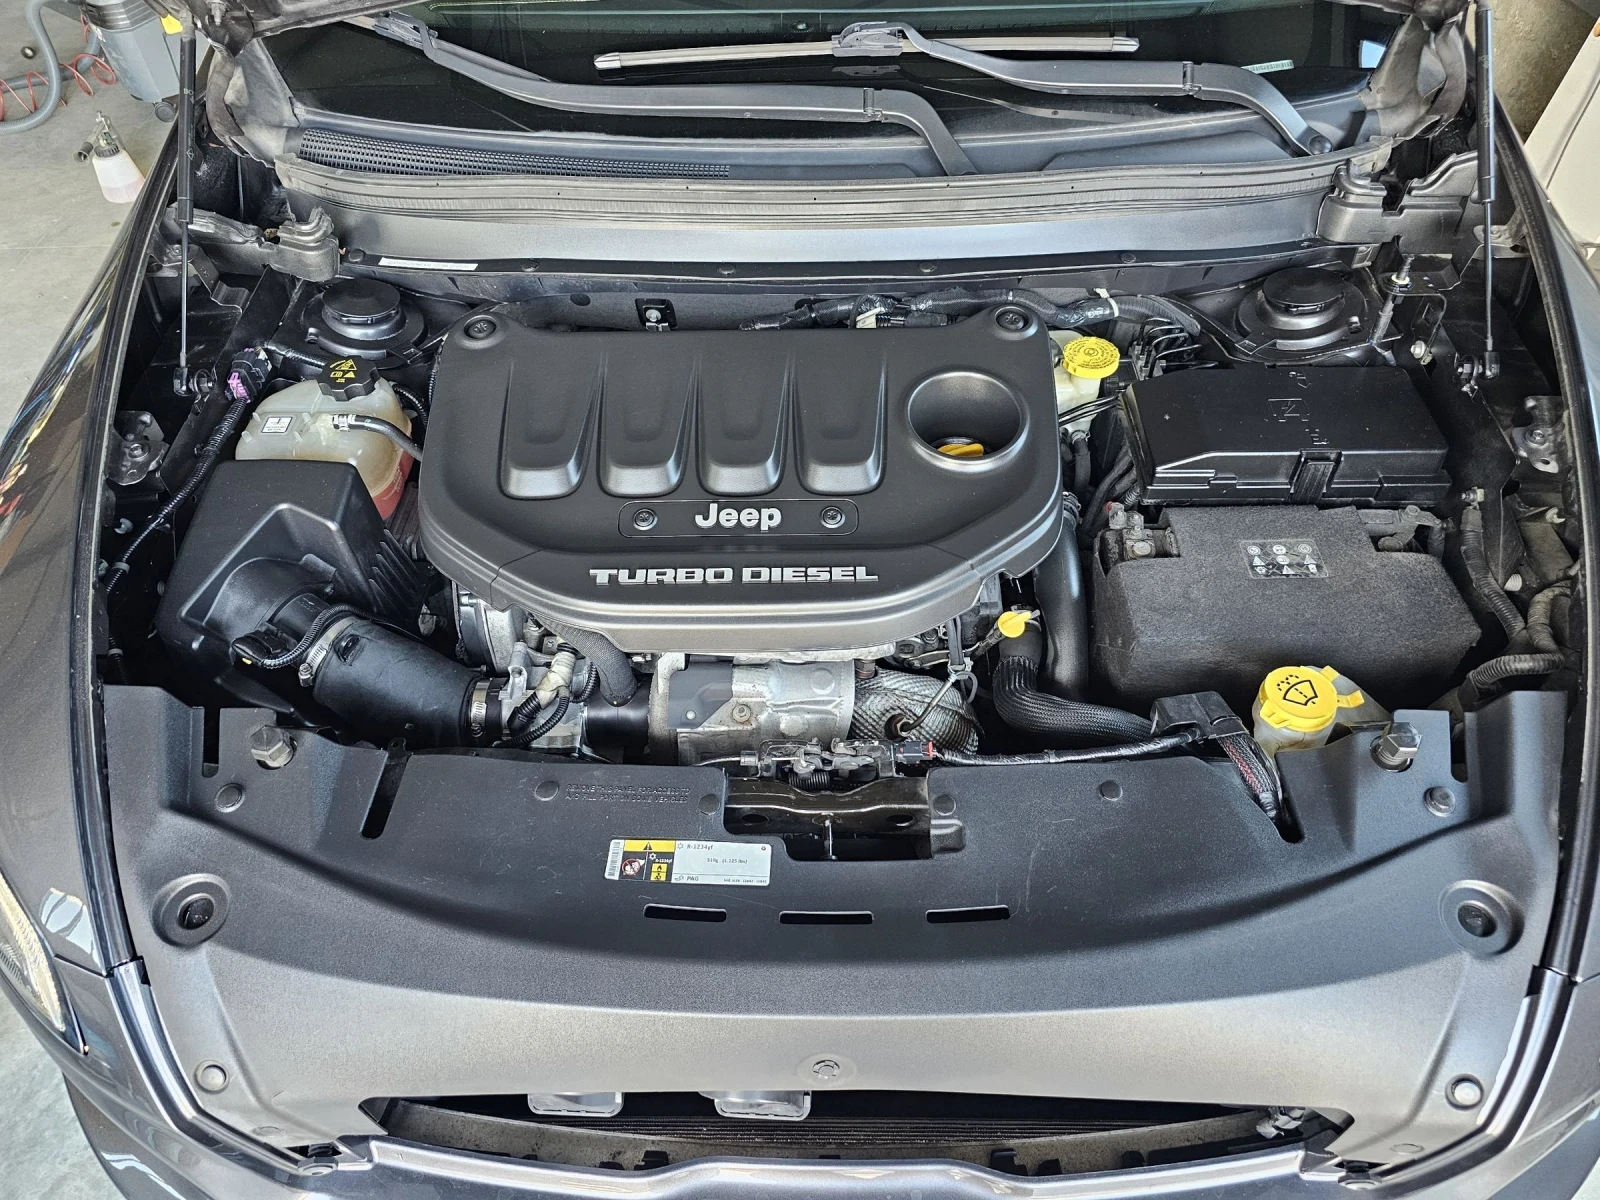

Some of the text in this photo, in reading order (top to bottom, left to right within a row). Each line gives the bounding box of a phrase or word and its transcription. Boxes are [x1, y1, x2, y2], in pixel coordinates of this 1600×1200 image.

[694, 503, 782, 532] Jeep
[589, 566, 879, 586] TURBO DIESEL
[566, 783, 596, 792] REMOVE
[597, 785, 612, 793] THIS
[614, 785, 636, 794] PANEL
[652, 787, 680, 795] ACCESS
[654, 796, 689, 804] VEHICLES
